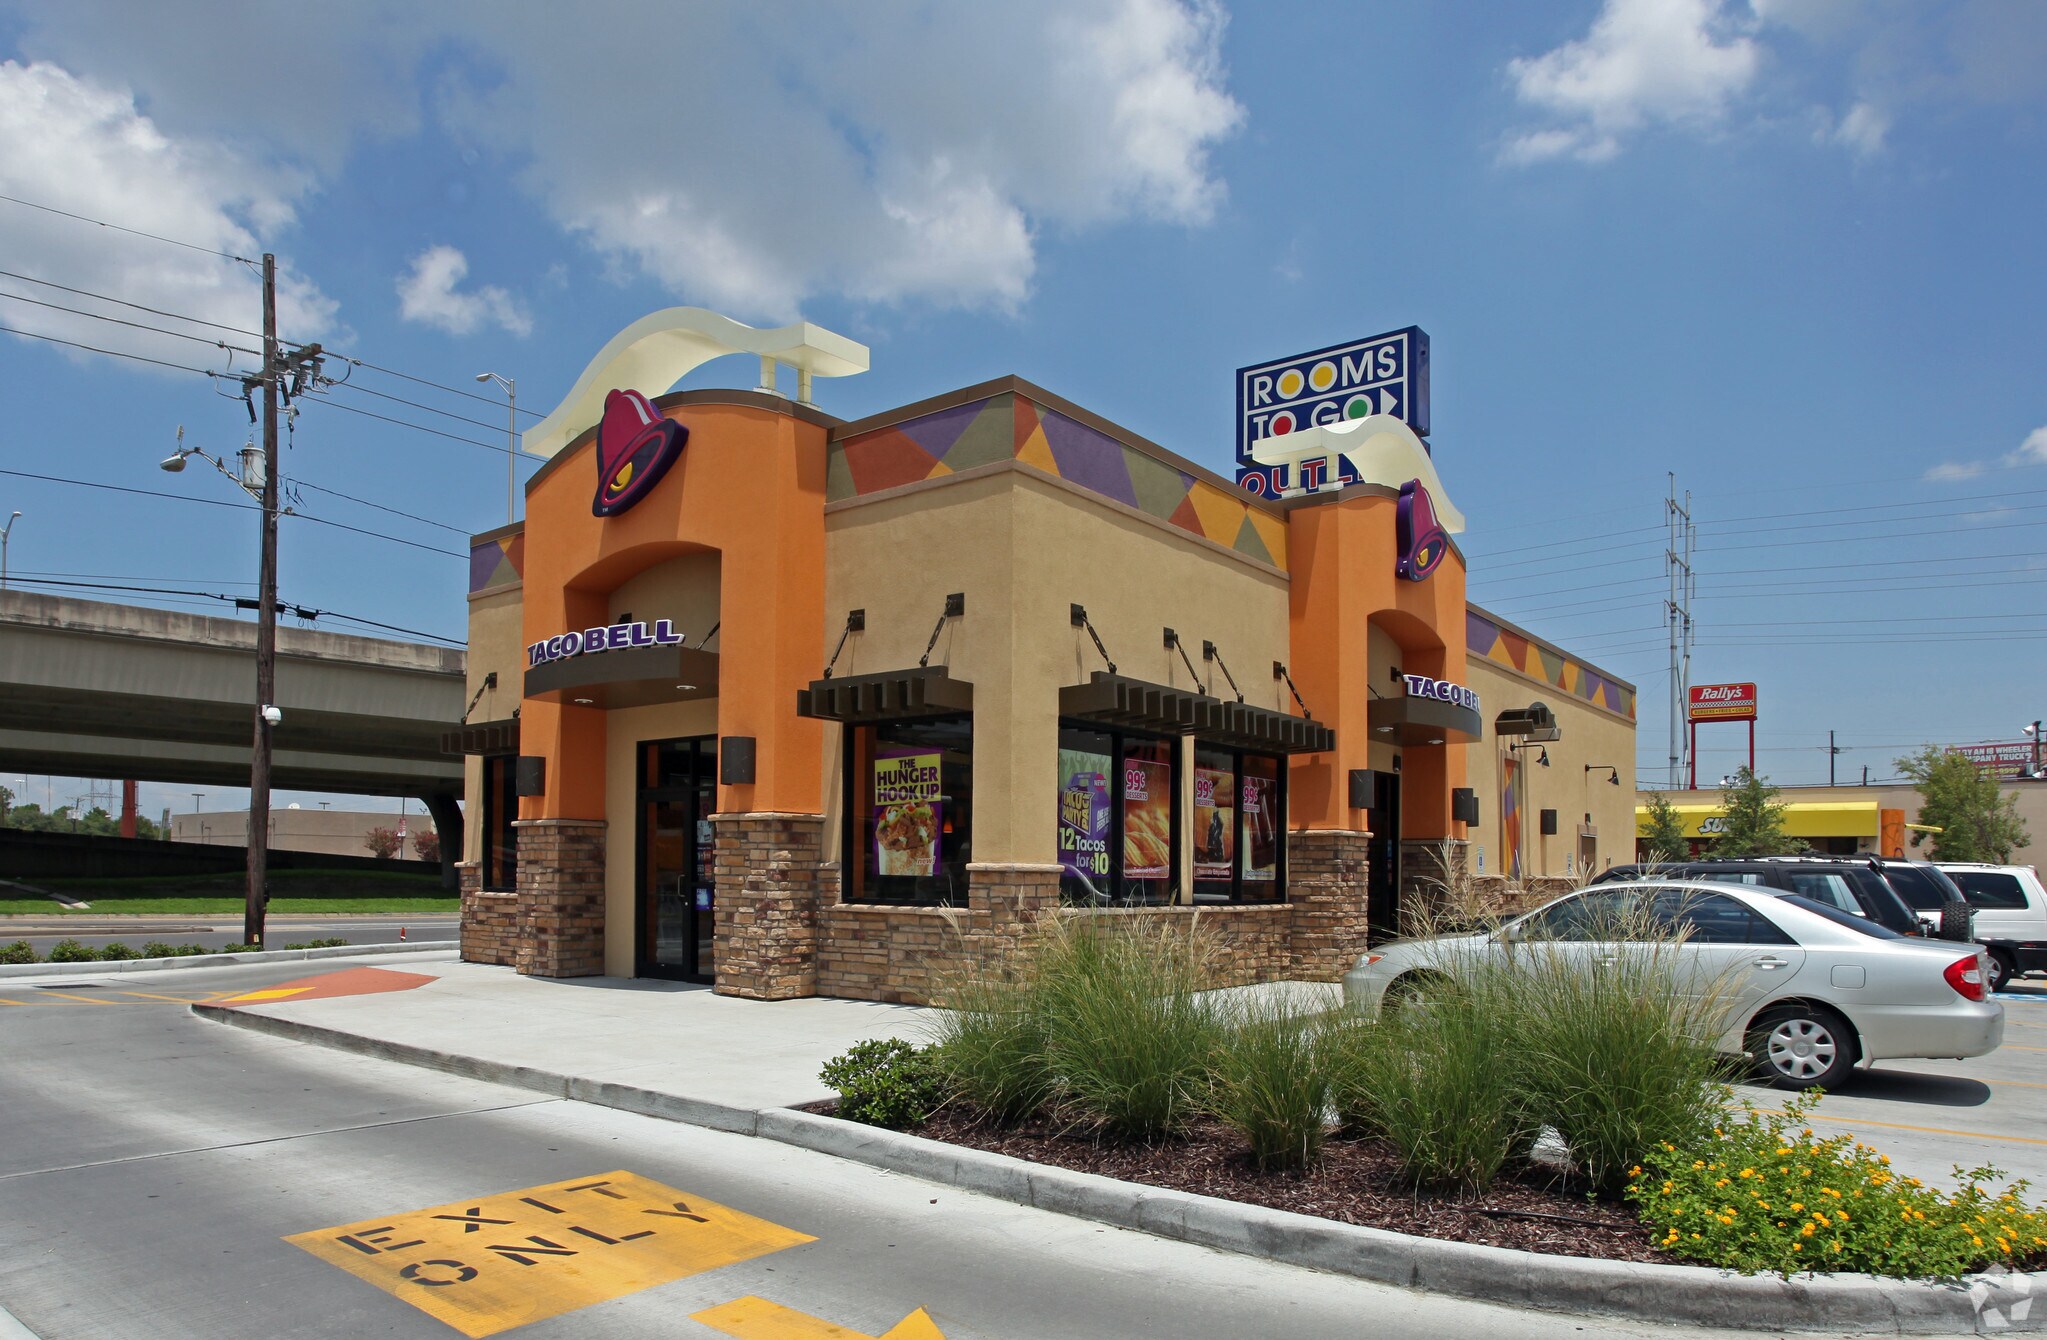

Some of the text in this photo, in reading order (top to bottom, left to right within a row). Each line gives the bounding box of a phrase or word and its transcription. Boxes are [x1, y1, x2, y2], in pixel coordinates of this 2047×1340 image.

[1253, 345, 1397, 406] ROOMS
[1252, 394, 1374, 440] TO GO
[527, 619, 686, 666] TACO BELL
[1403, 674, 1461, 705] TACO
[1699, 686, 1743, 701] Rally's
[1995, 745, 2032, 754] WHEELER
[1998, 753, 2033, 763] TRUCK?
[898, 758, 916, 769] THE
[877, 767, 938, 787] HUNGER
[877, 784, 940, 802] HOOK UP
[1126, 791, 1148, 801] DESSERTS
[1059, 827, 1105, 852] 12 Tacos
[1076, 852, 1109, 875] for $10
[335, 1181, 629, 1255] EXIT
[399, 1202, 711, 1287] ONLY
